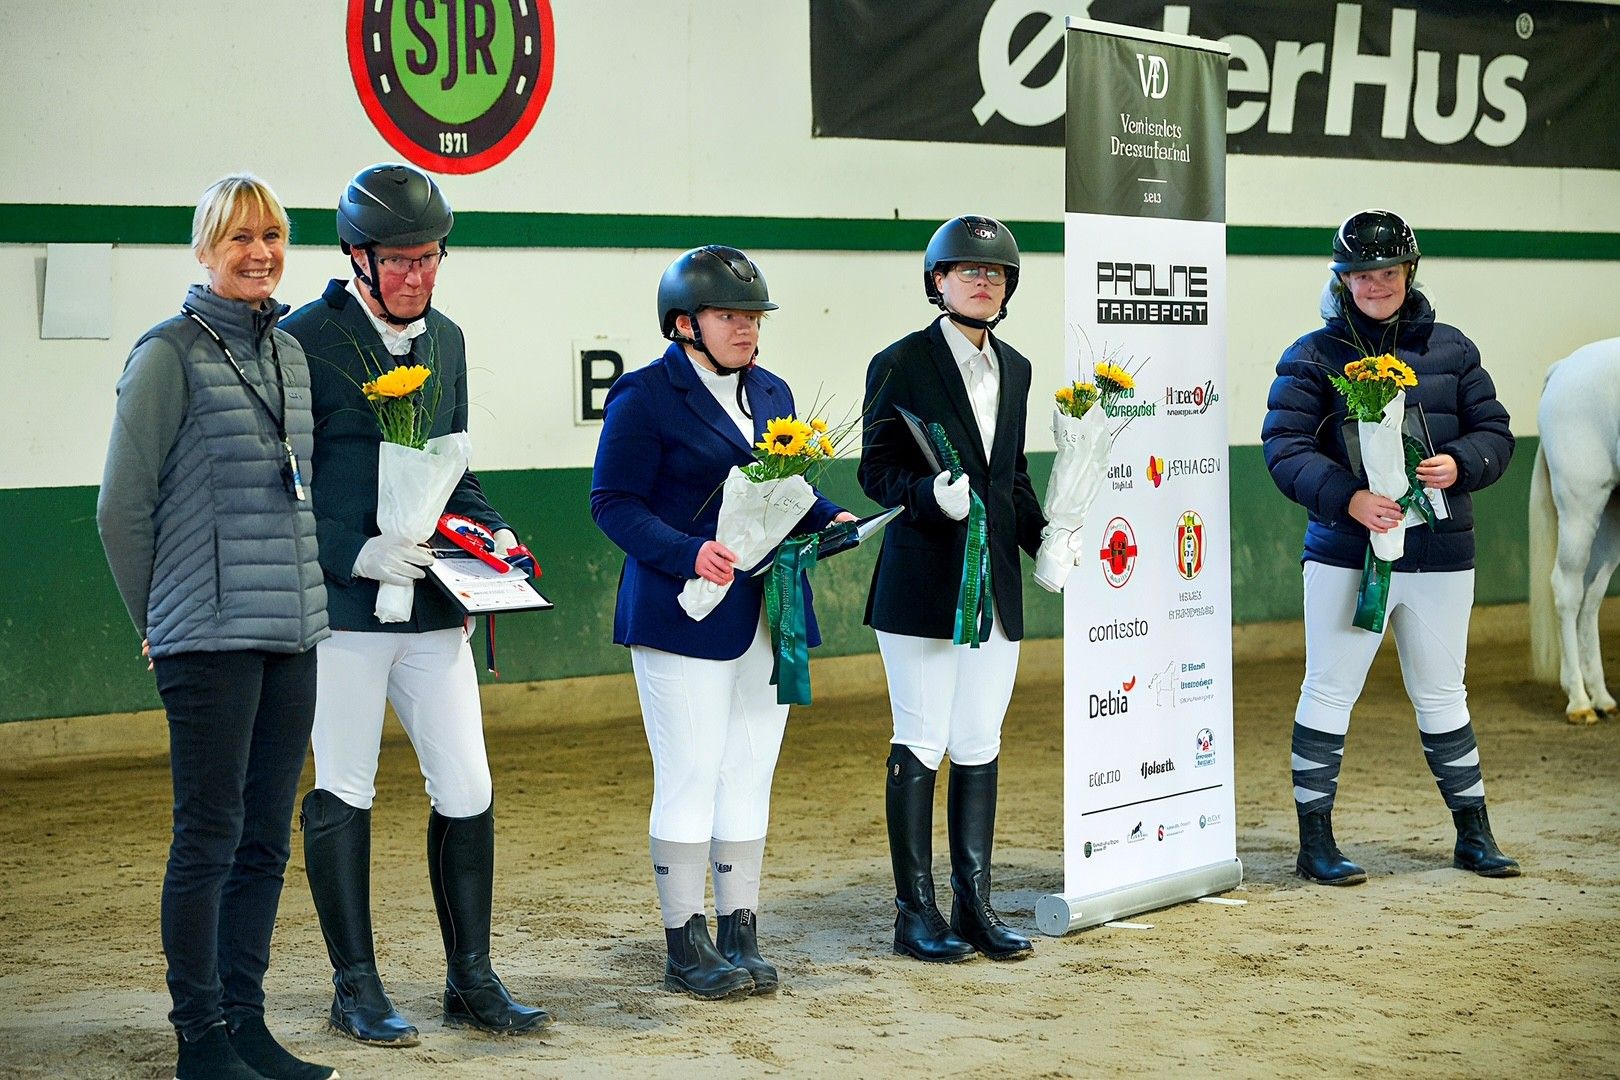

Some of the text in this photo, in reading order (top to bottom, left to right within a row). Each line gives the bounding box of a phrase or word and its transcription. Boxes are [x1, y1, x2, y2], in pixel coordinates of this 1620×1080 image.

[405, 0, 498, 91] SJR
[438, 132, 468, 154] 1971
[580, 349, 624, 420] B
[1089, 689, 1128, 719] Debia
